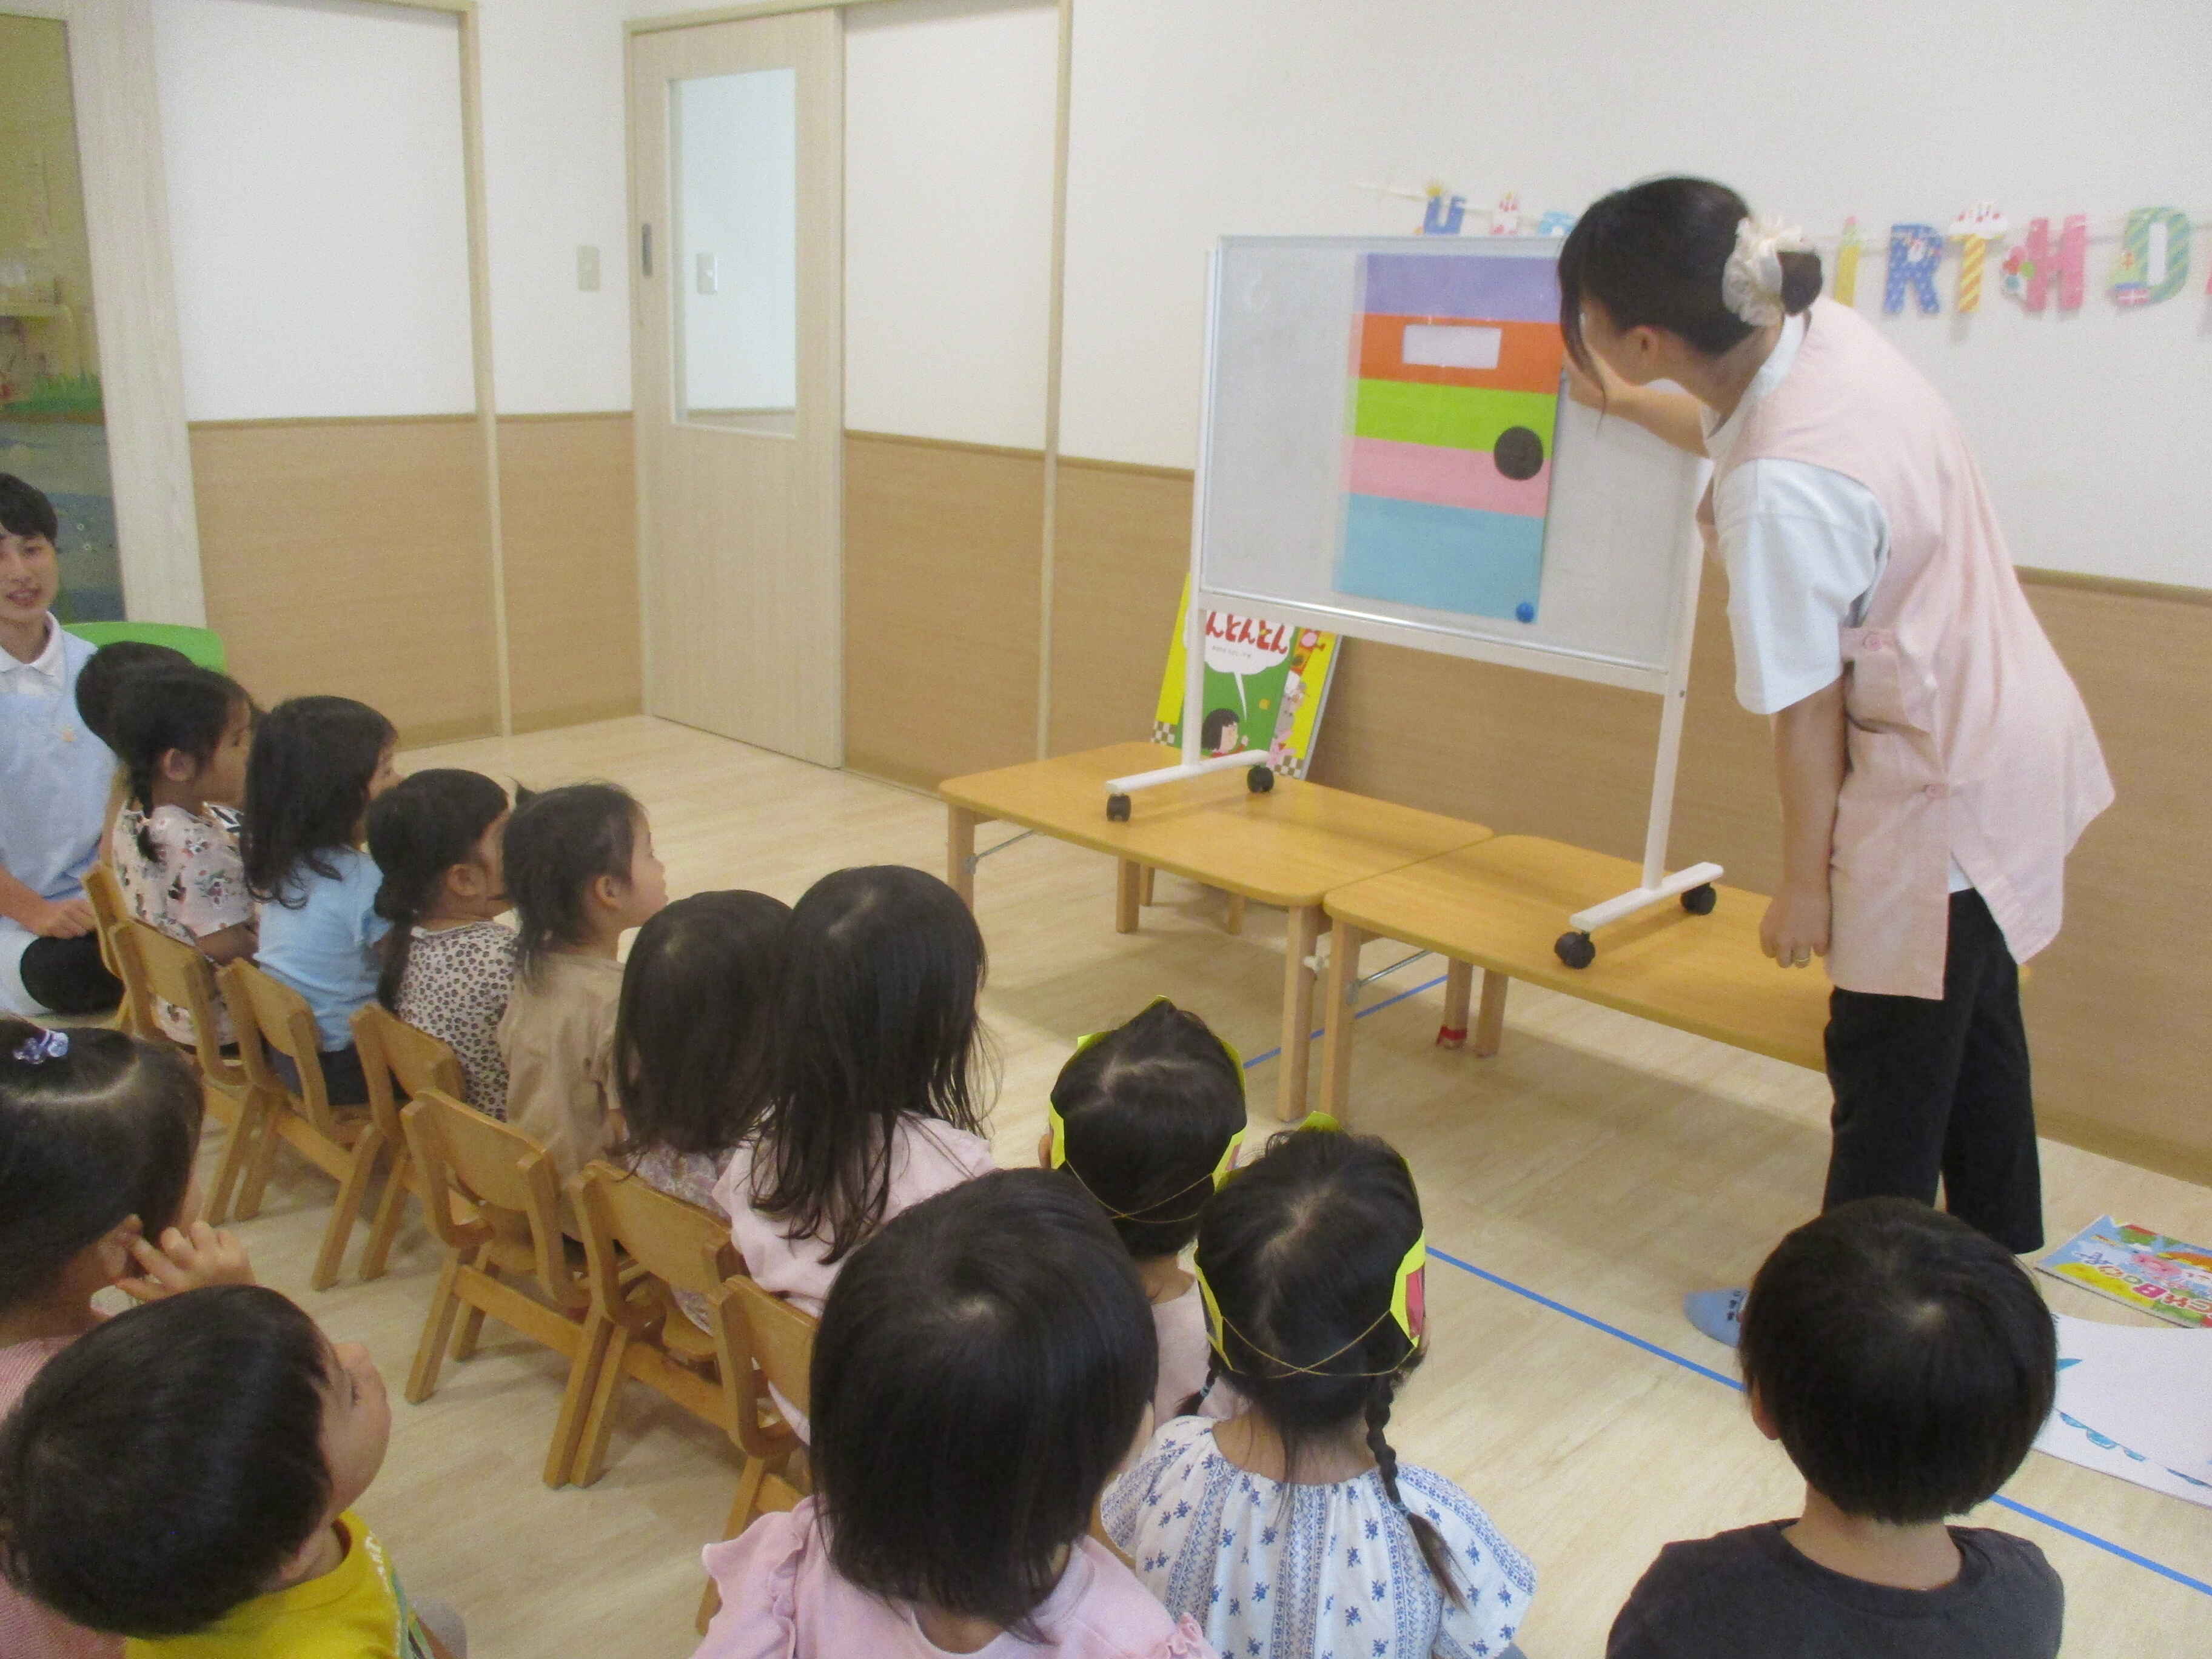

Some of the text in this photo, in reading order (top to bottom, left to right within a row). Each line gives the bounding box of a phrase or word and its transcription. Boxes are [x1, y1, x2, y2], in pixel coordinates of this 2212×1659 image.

[1832, 201, 2212, 314] IRTHD
[1205, 611, 1288, 654] んとんとん
